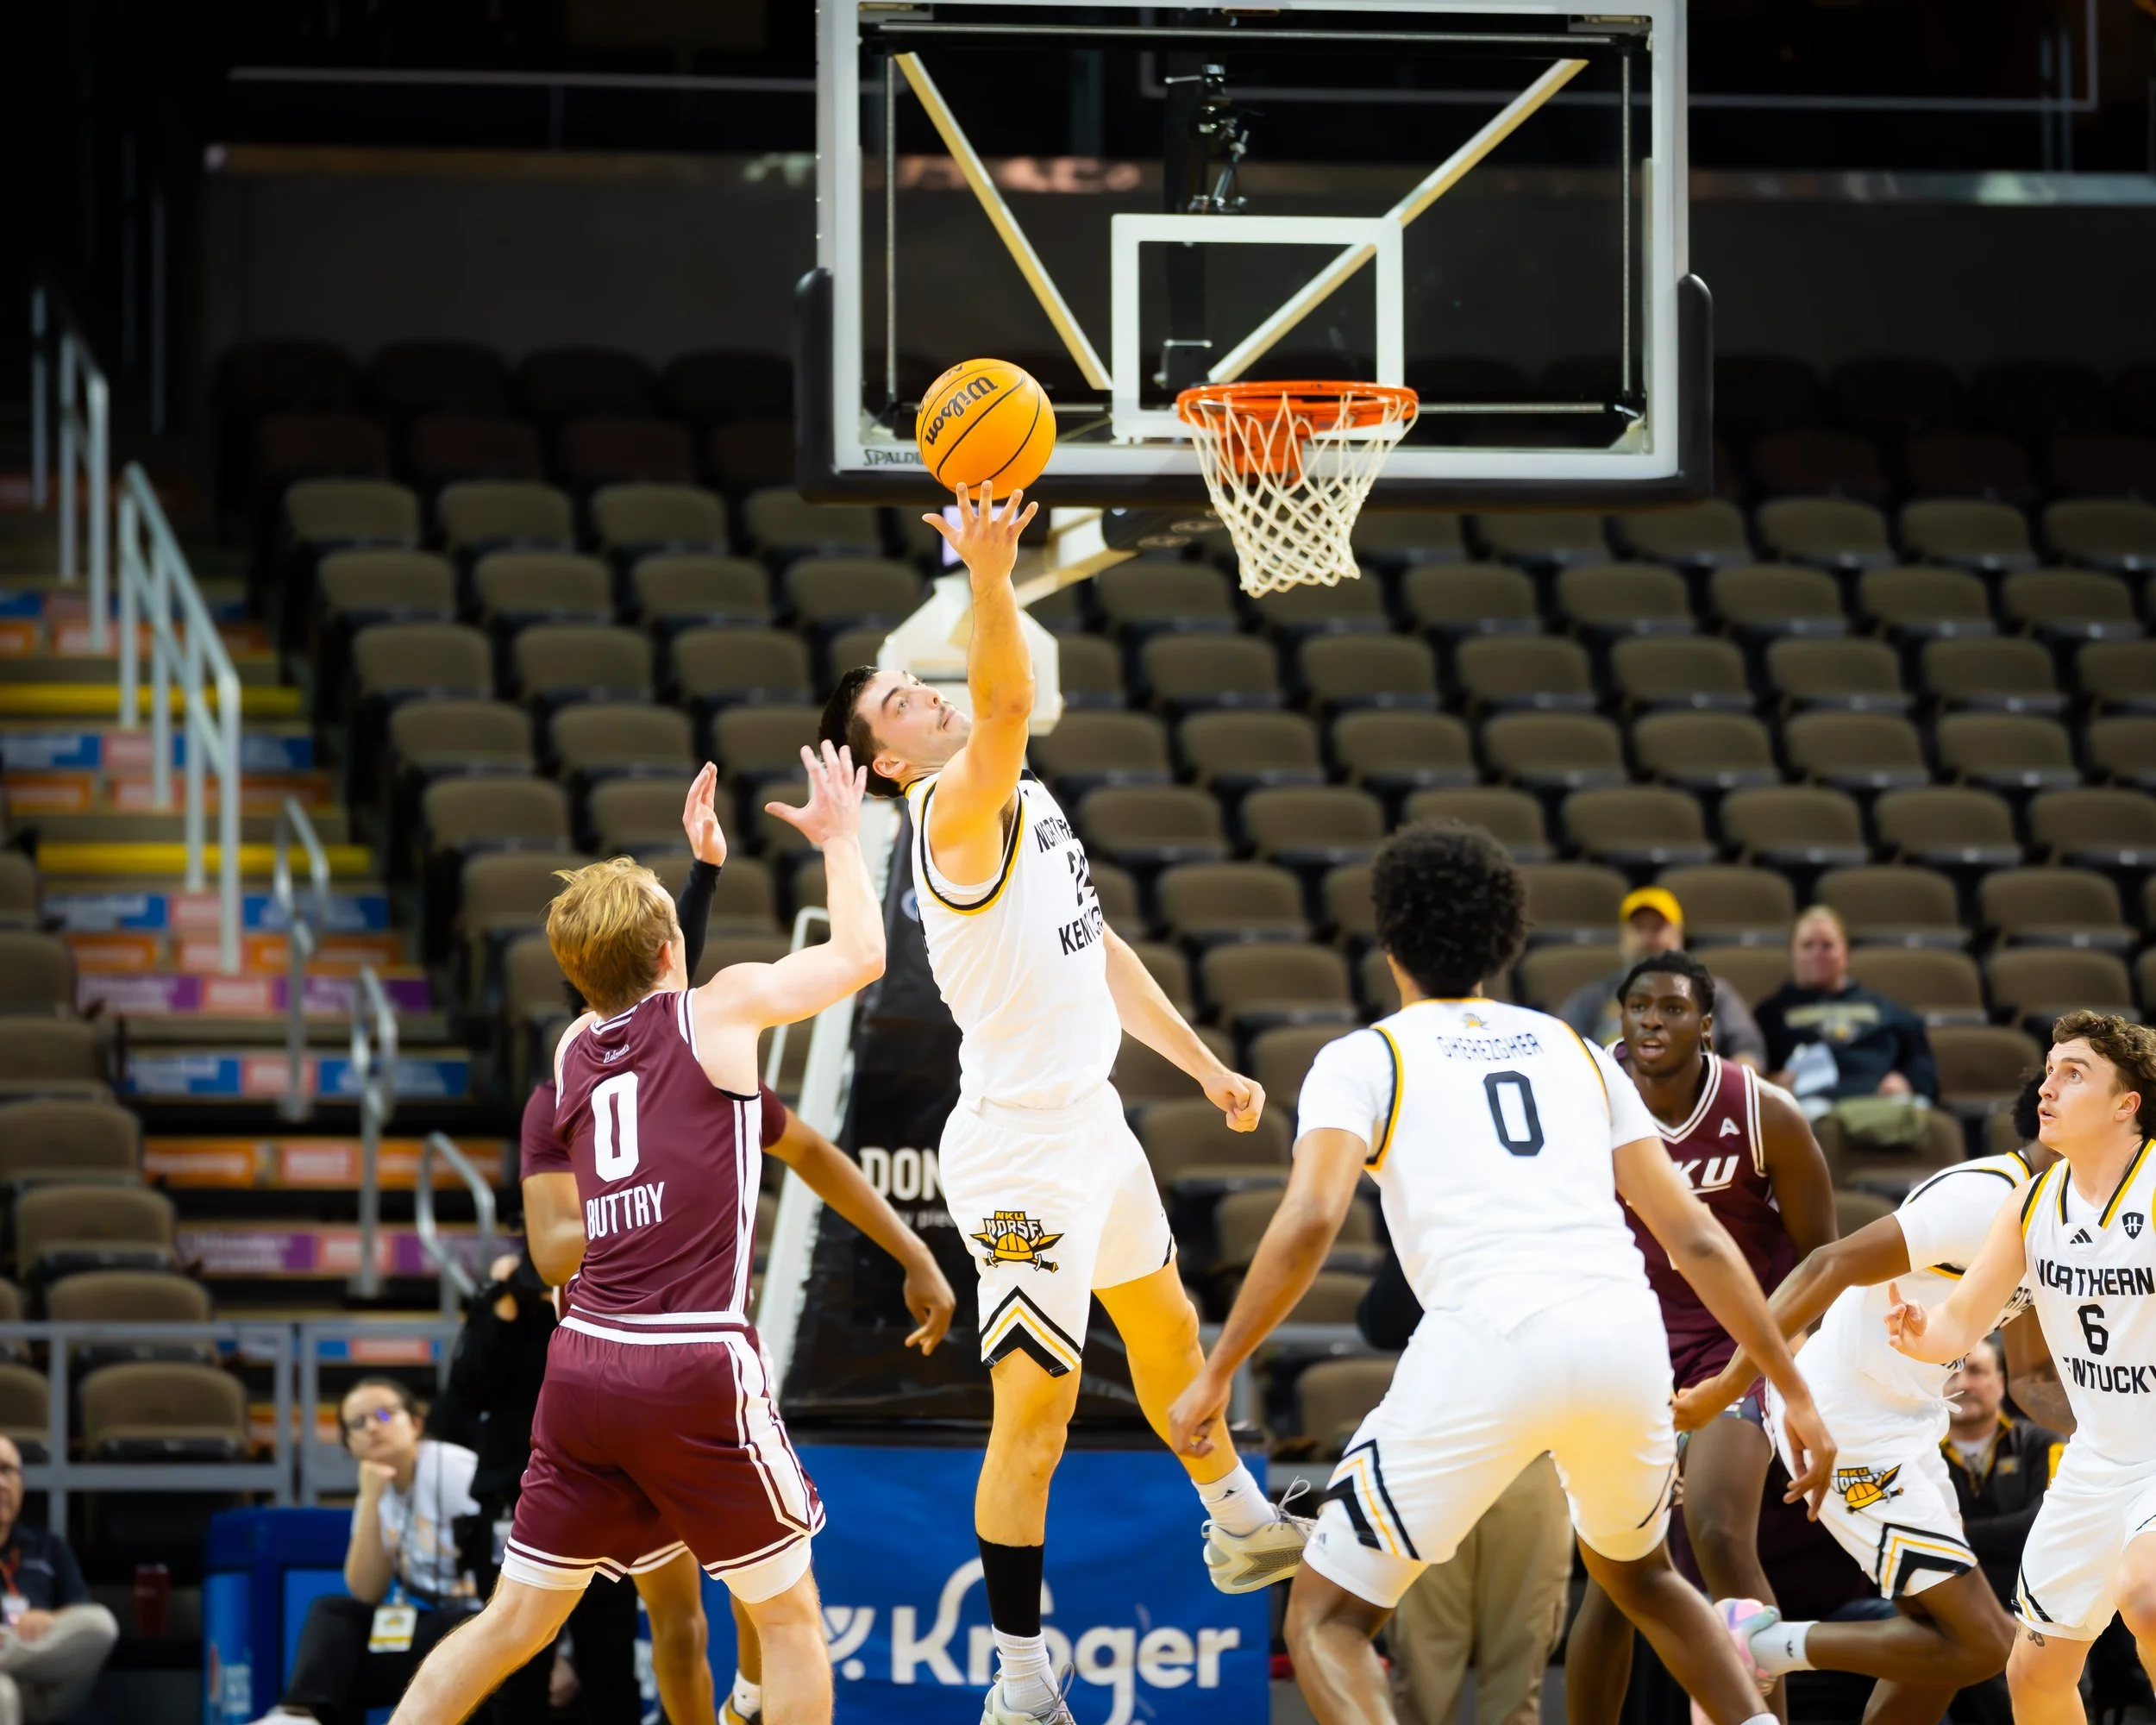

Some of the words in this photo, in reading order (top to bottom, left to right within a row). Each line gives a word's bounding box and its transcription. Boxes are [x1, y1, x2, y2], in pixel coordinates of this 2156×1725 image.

[924, 376, 998, 446] Wilson
[591, 1070, 639, 1182] 0
[1482, 1070, 1545, 1157] 0
[1672, 1155, 1739, 1189] KU
[586, 1181, 665, 1240] BUTTRY
[995, 1211, 1025, 1220] NKU
[2034, 1256, 2155, 1297] NORTHERN
[2078, 1303, 2109, 1356] 6
